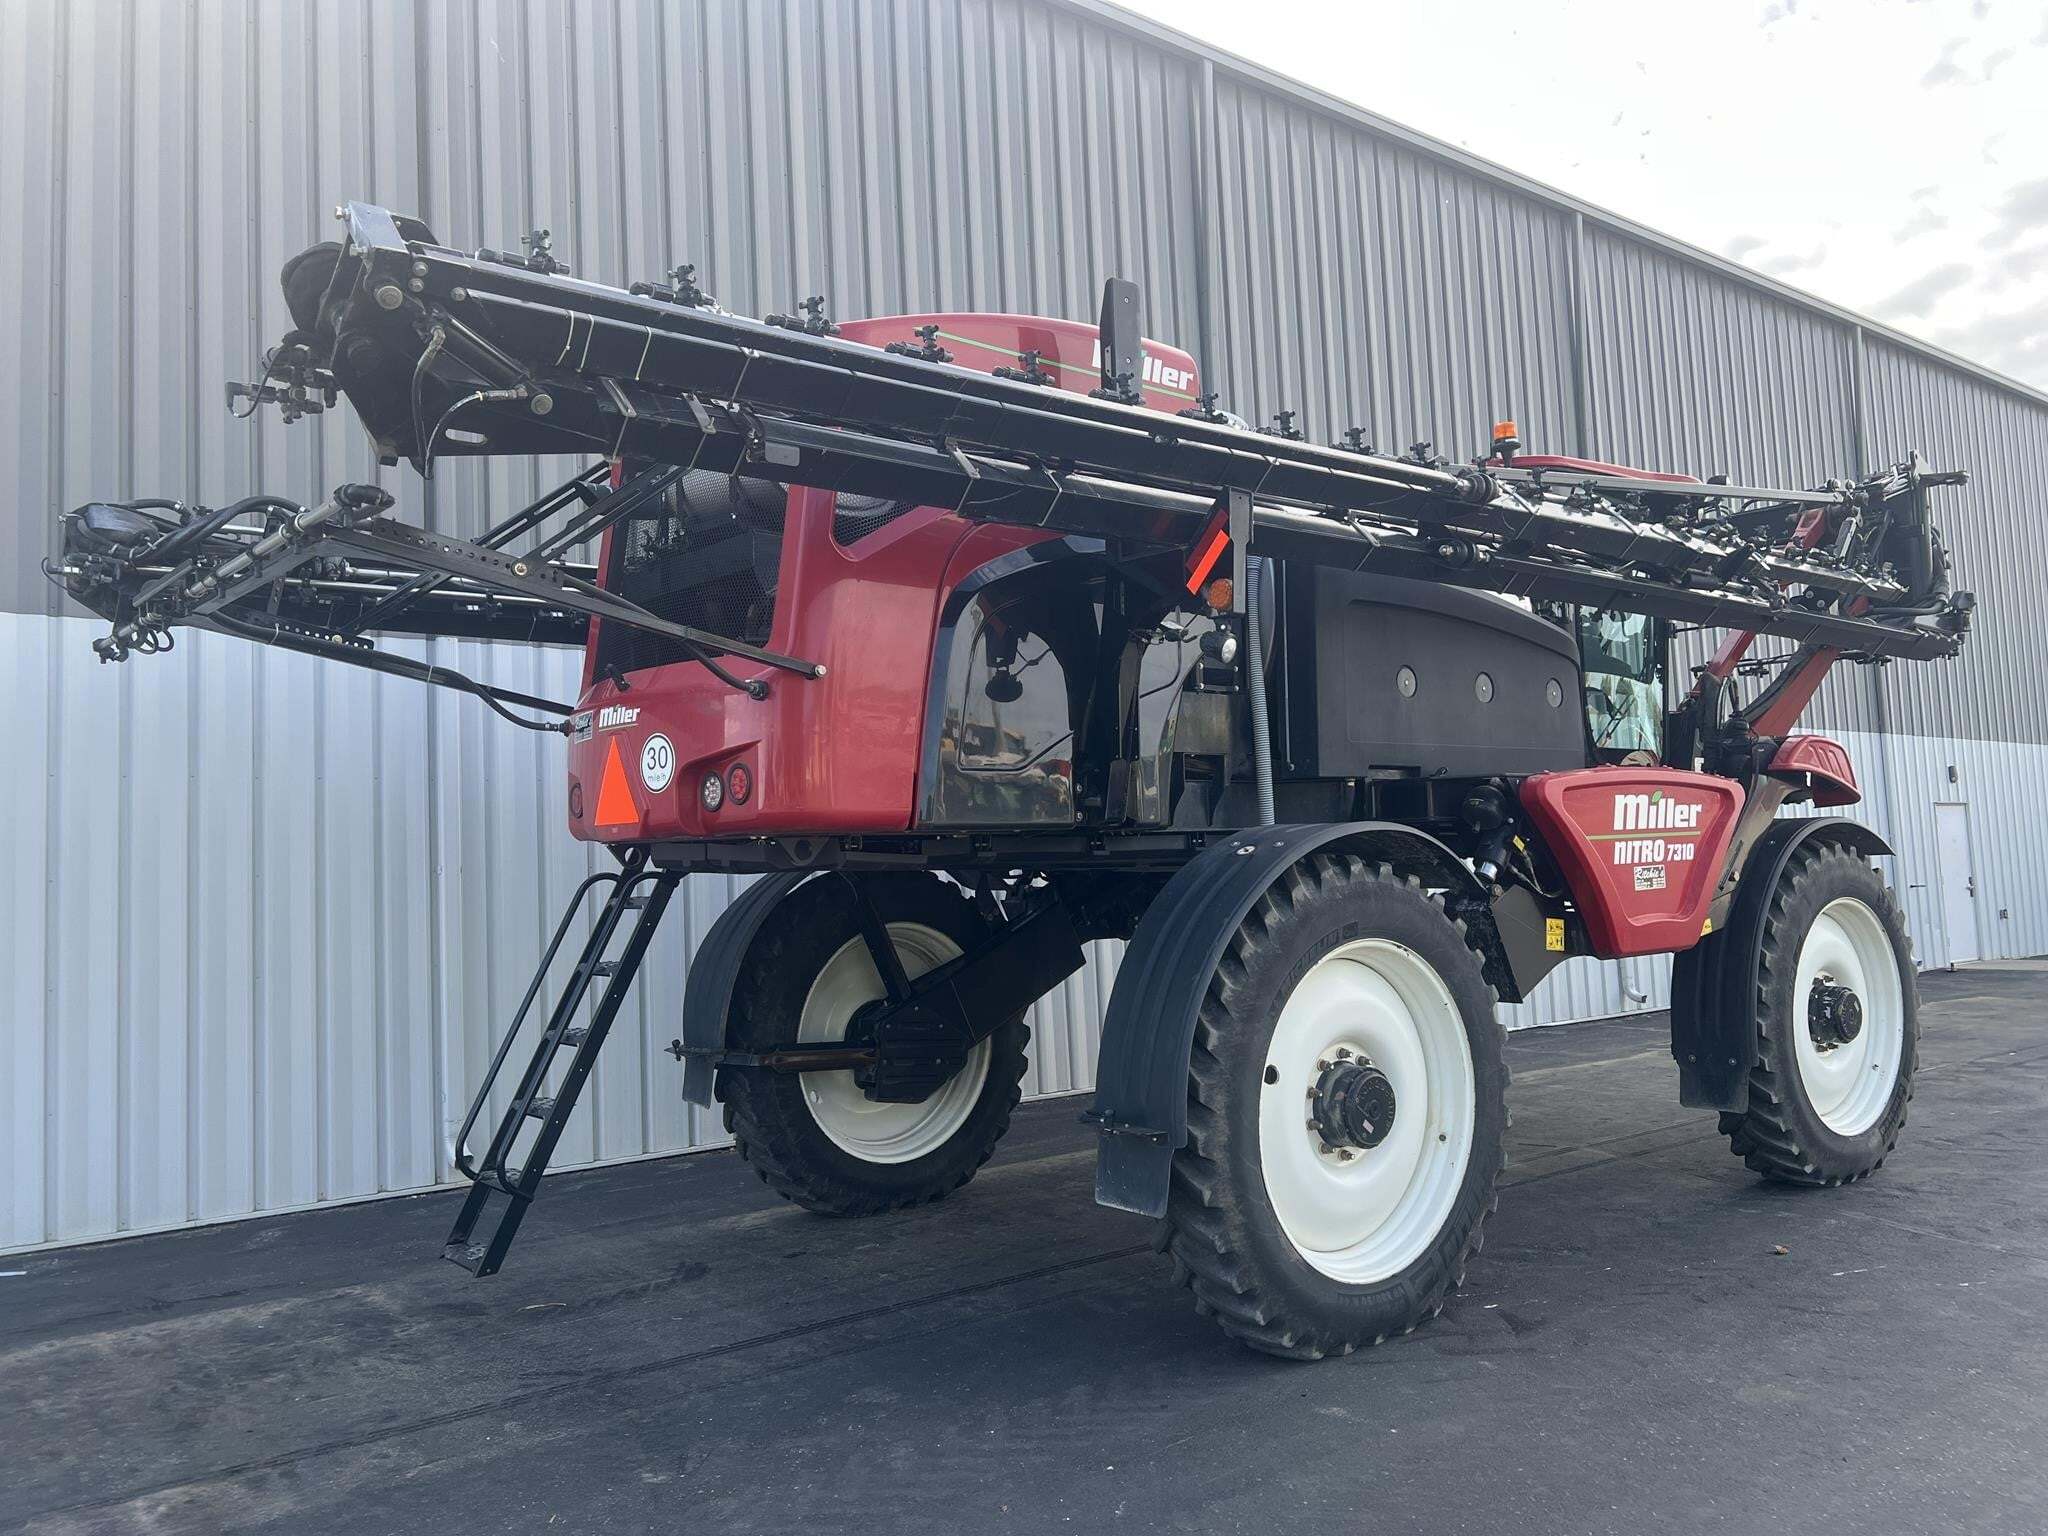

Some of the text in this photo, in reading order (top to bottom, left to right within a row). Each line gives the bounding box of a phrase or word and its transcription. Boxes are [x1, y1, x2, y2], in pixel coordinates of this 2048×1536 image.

[1092, 338, 1194, 391] ller
[598, 704, 641, 728] Miller
[647, 745, 668, 770] 30
[1613, 790, 1703, 831] Miller
[1613, 839, 1695, 865] NITRO 7310
